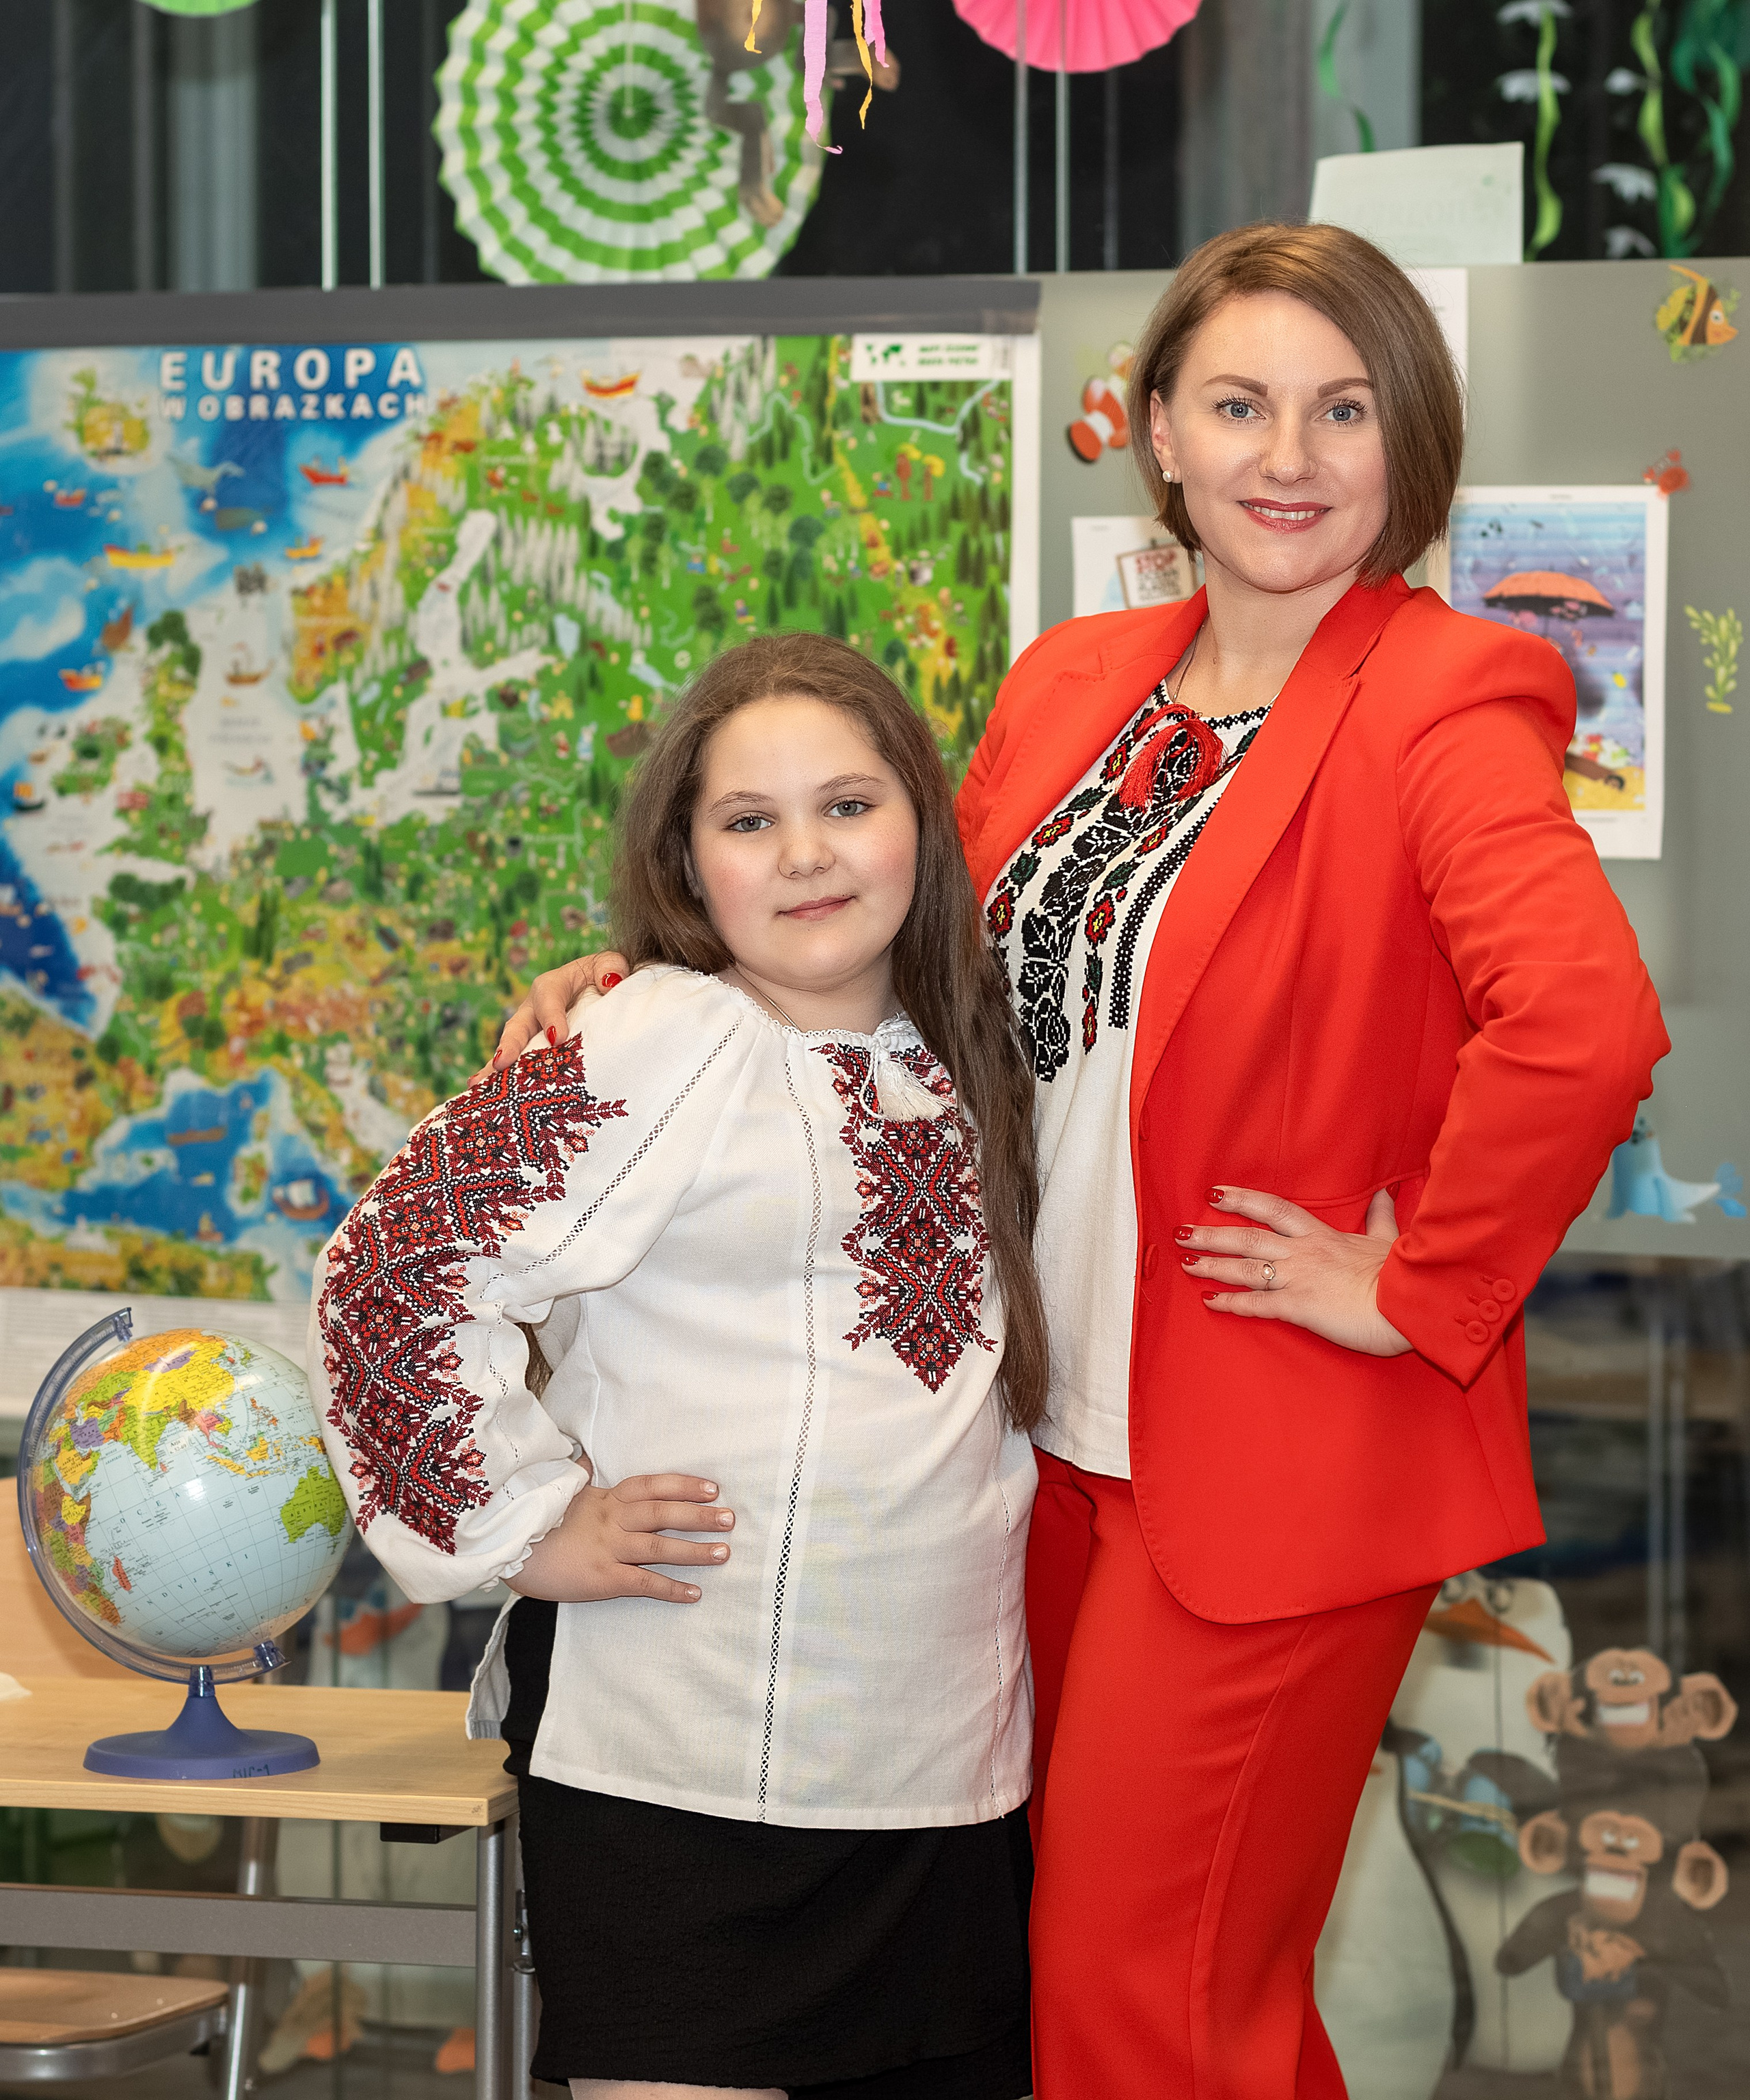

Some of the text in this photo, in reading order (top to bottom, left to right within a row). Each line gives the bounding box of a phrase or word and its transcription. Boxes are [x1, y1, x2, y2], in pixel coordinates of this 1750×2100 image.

[160, 348, 422, 391] EUROPA
[161, 392, 426, 421] W OBRAZKACH
[135, 1553, 249, 1612] INDYJSKI
